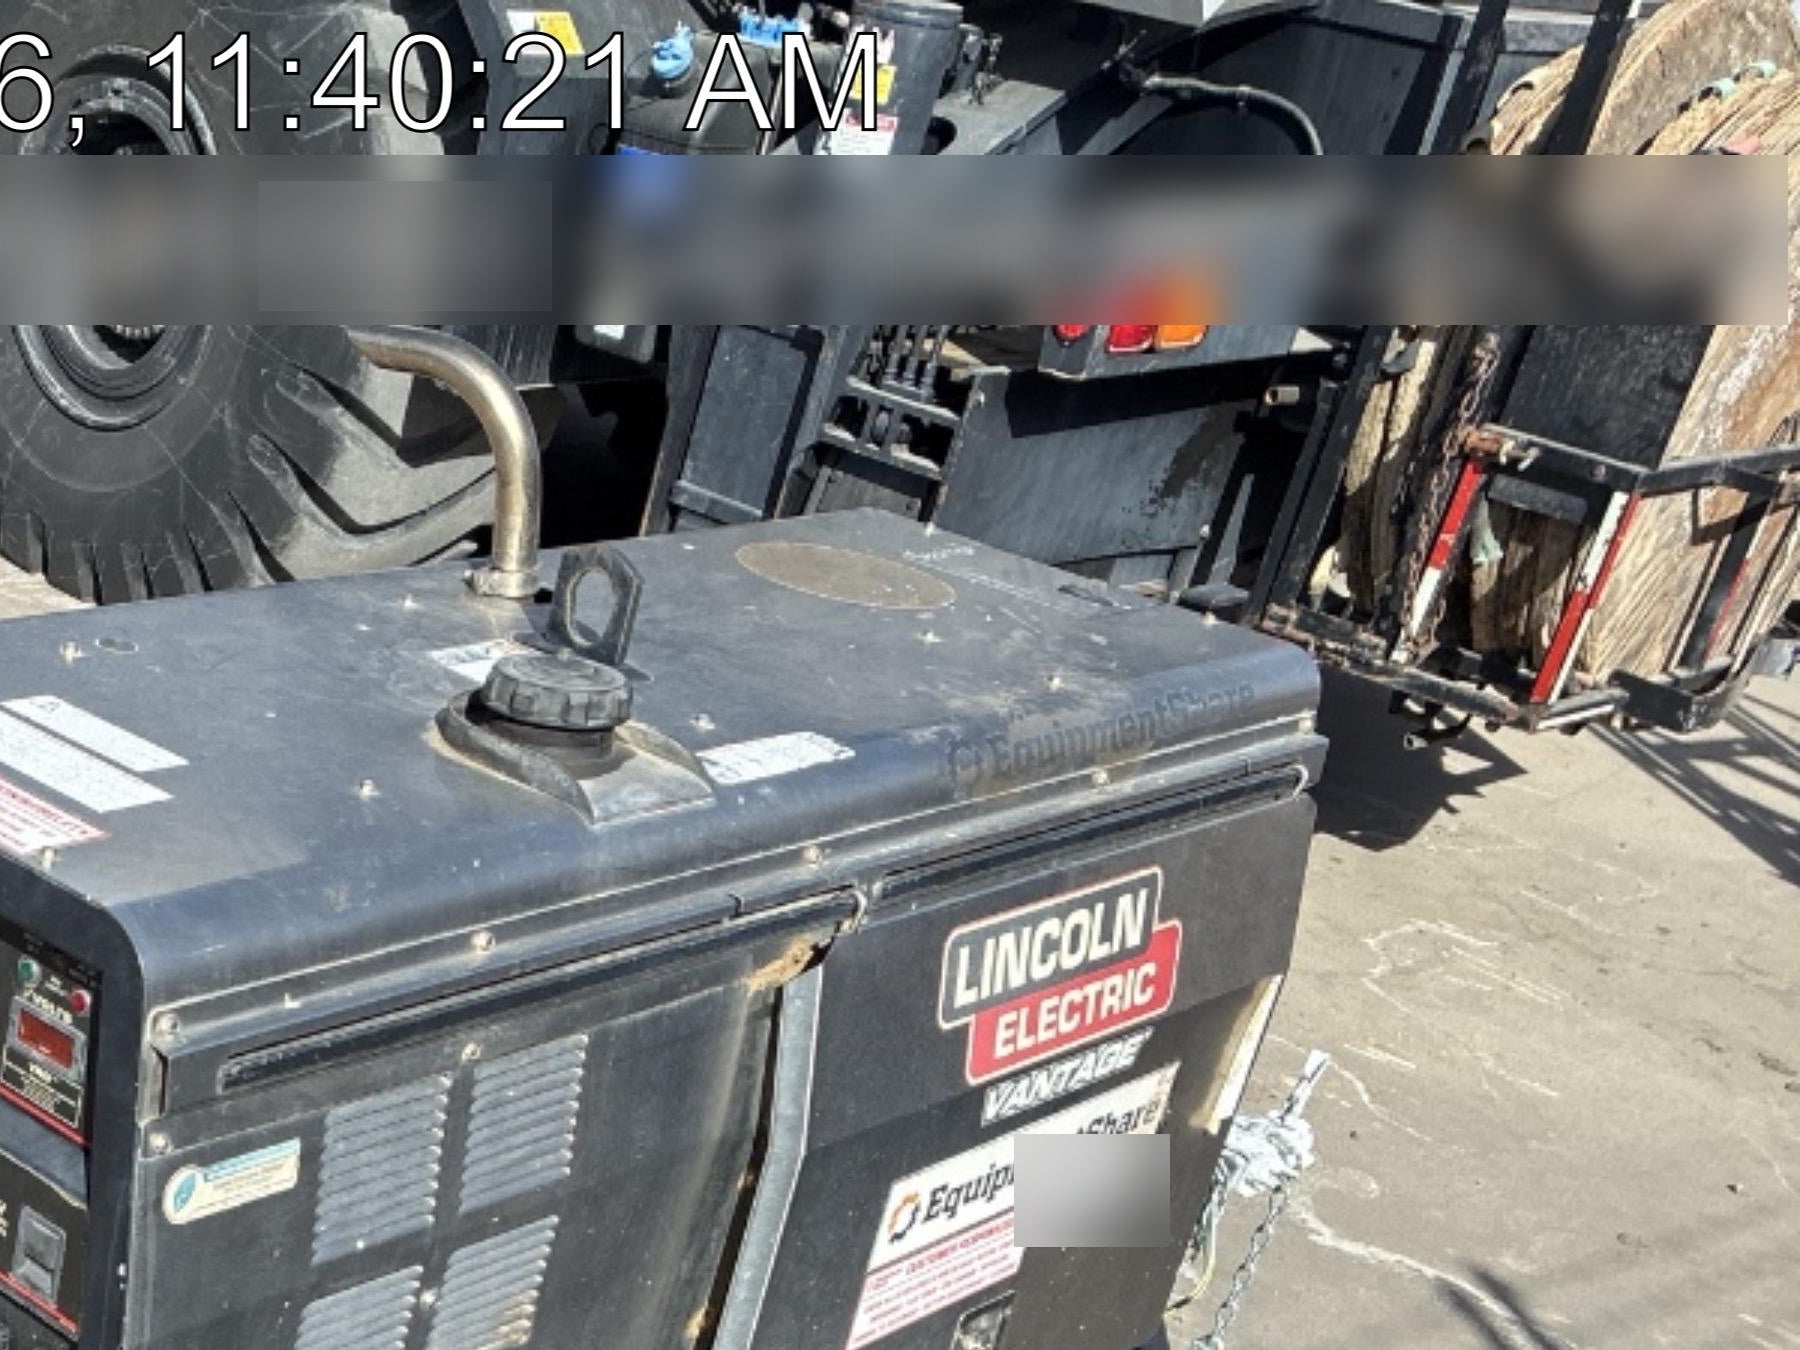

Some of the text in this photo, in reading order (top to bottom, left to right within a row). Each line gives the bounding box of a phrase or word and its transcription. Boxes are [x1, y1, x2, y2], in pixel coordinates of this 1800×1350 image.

[953, 888, 1149, 1009] LINCOLN
[994, 962, 1157, 1060] ELECTRIC
[982, 1034, 1148, 1126] VANTAGE
